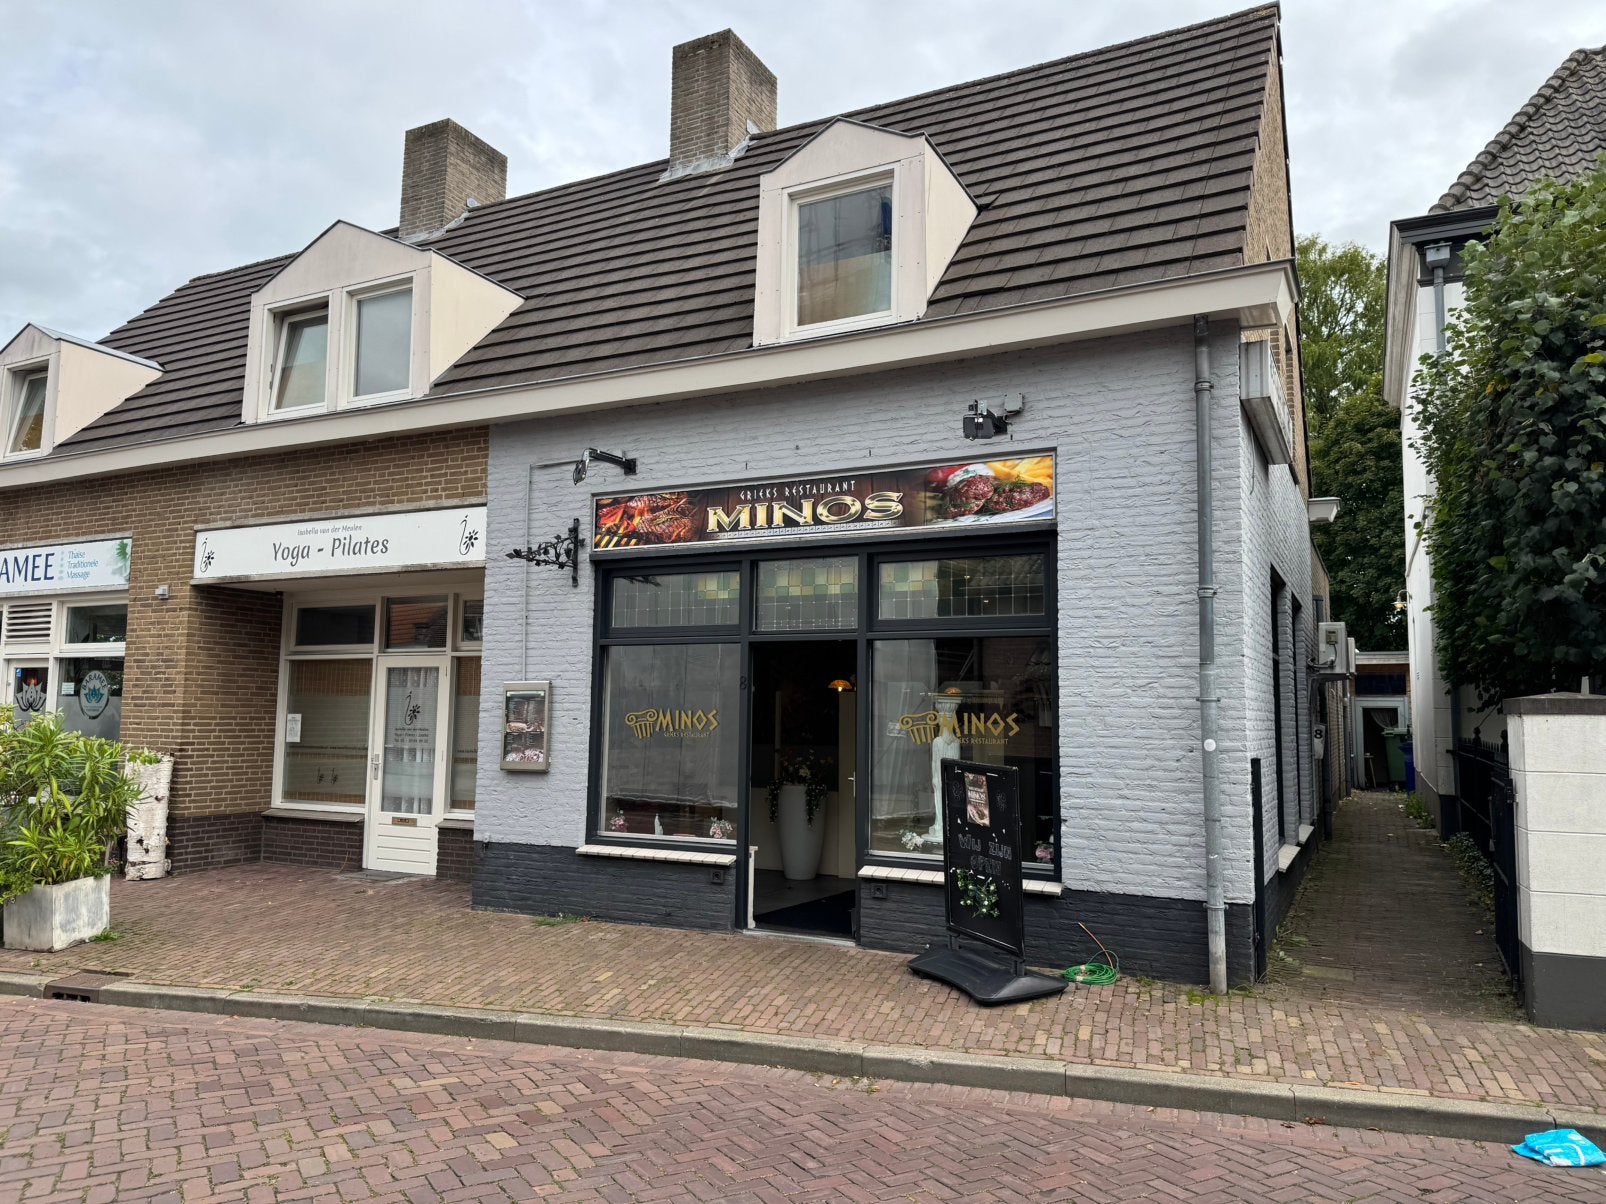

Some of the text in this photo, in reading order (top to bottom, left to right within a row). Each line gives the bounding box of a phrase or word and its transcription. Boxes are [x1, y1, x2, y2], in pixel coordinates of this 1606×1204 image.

[739, 480, 857, 501] GRIEKS RESTAURANT
[707, 492, 904, 532] MINOS
[331, 525, 341, 534] der
[67, 550, 86, 560] Thaise
[272, 541, 311, 567] Yoga
[330, 535, 390, 558] Pilates
[66, 559, 99, 569] Traditionele
[66, 570, 91, 581] Massage
[81, 672, 108, 692] BARAMEE
[655, 707, 720, 732] MINOS
[939, 710, 1020, 737] MINOS
[970, 737, 1009, 745] RESTAURANT
[1314, 729, 1323, 739] 8
